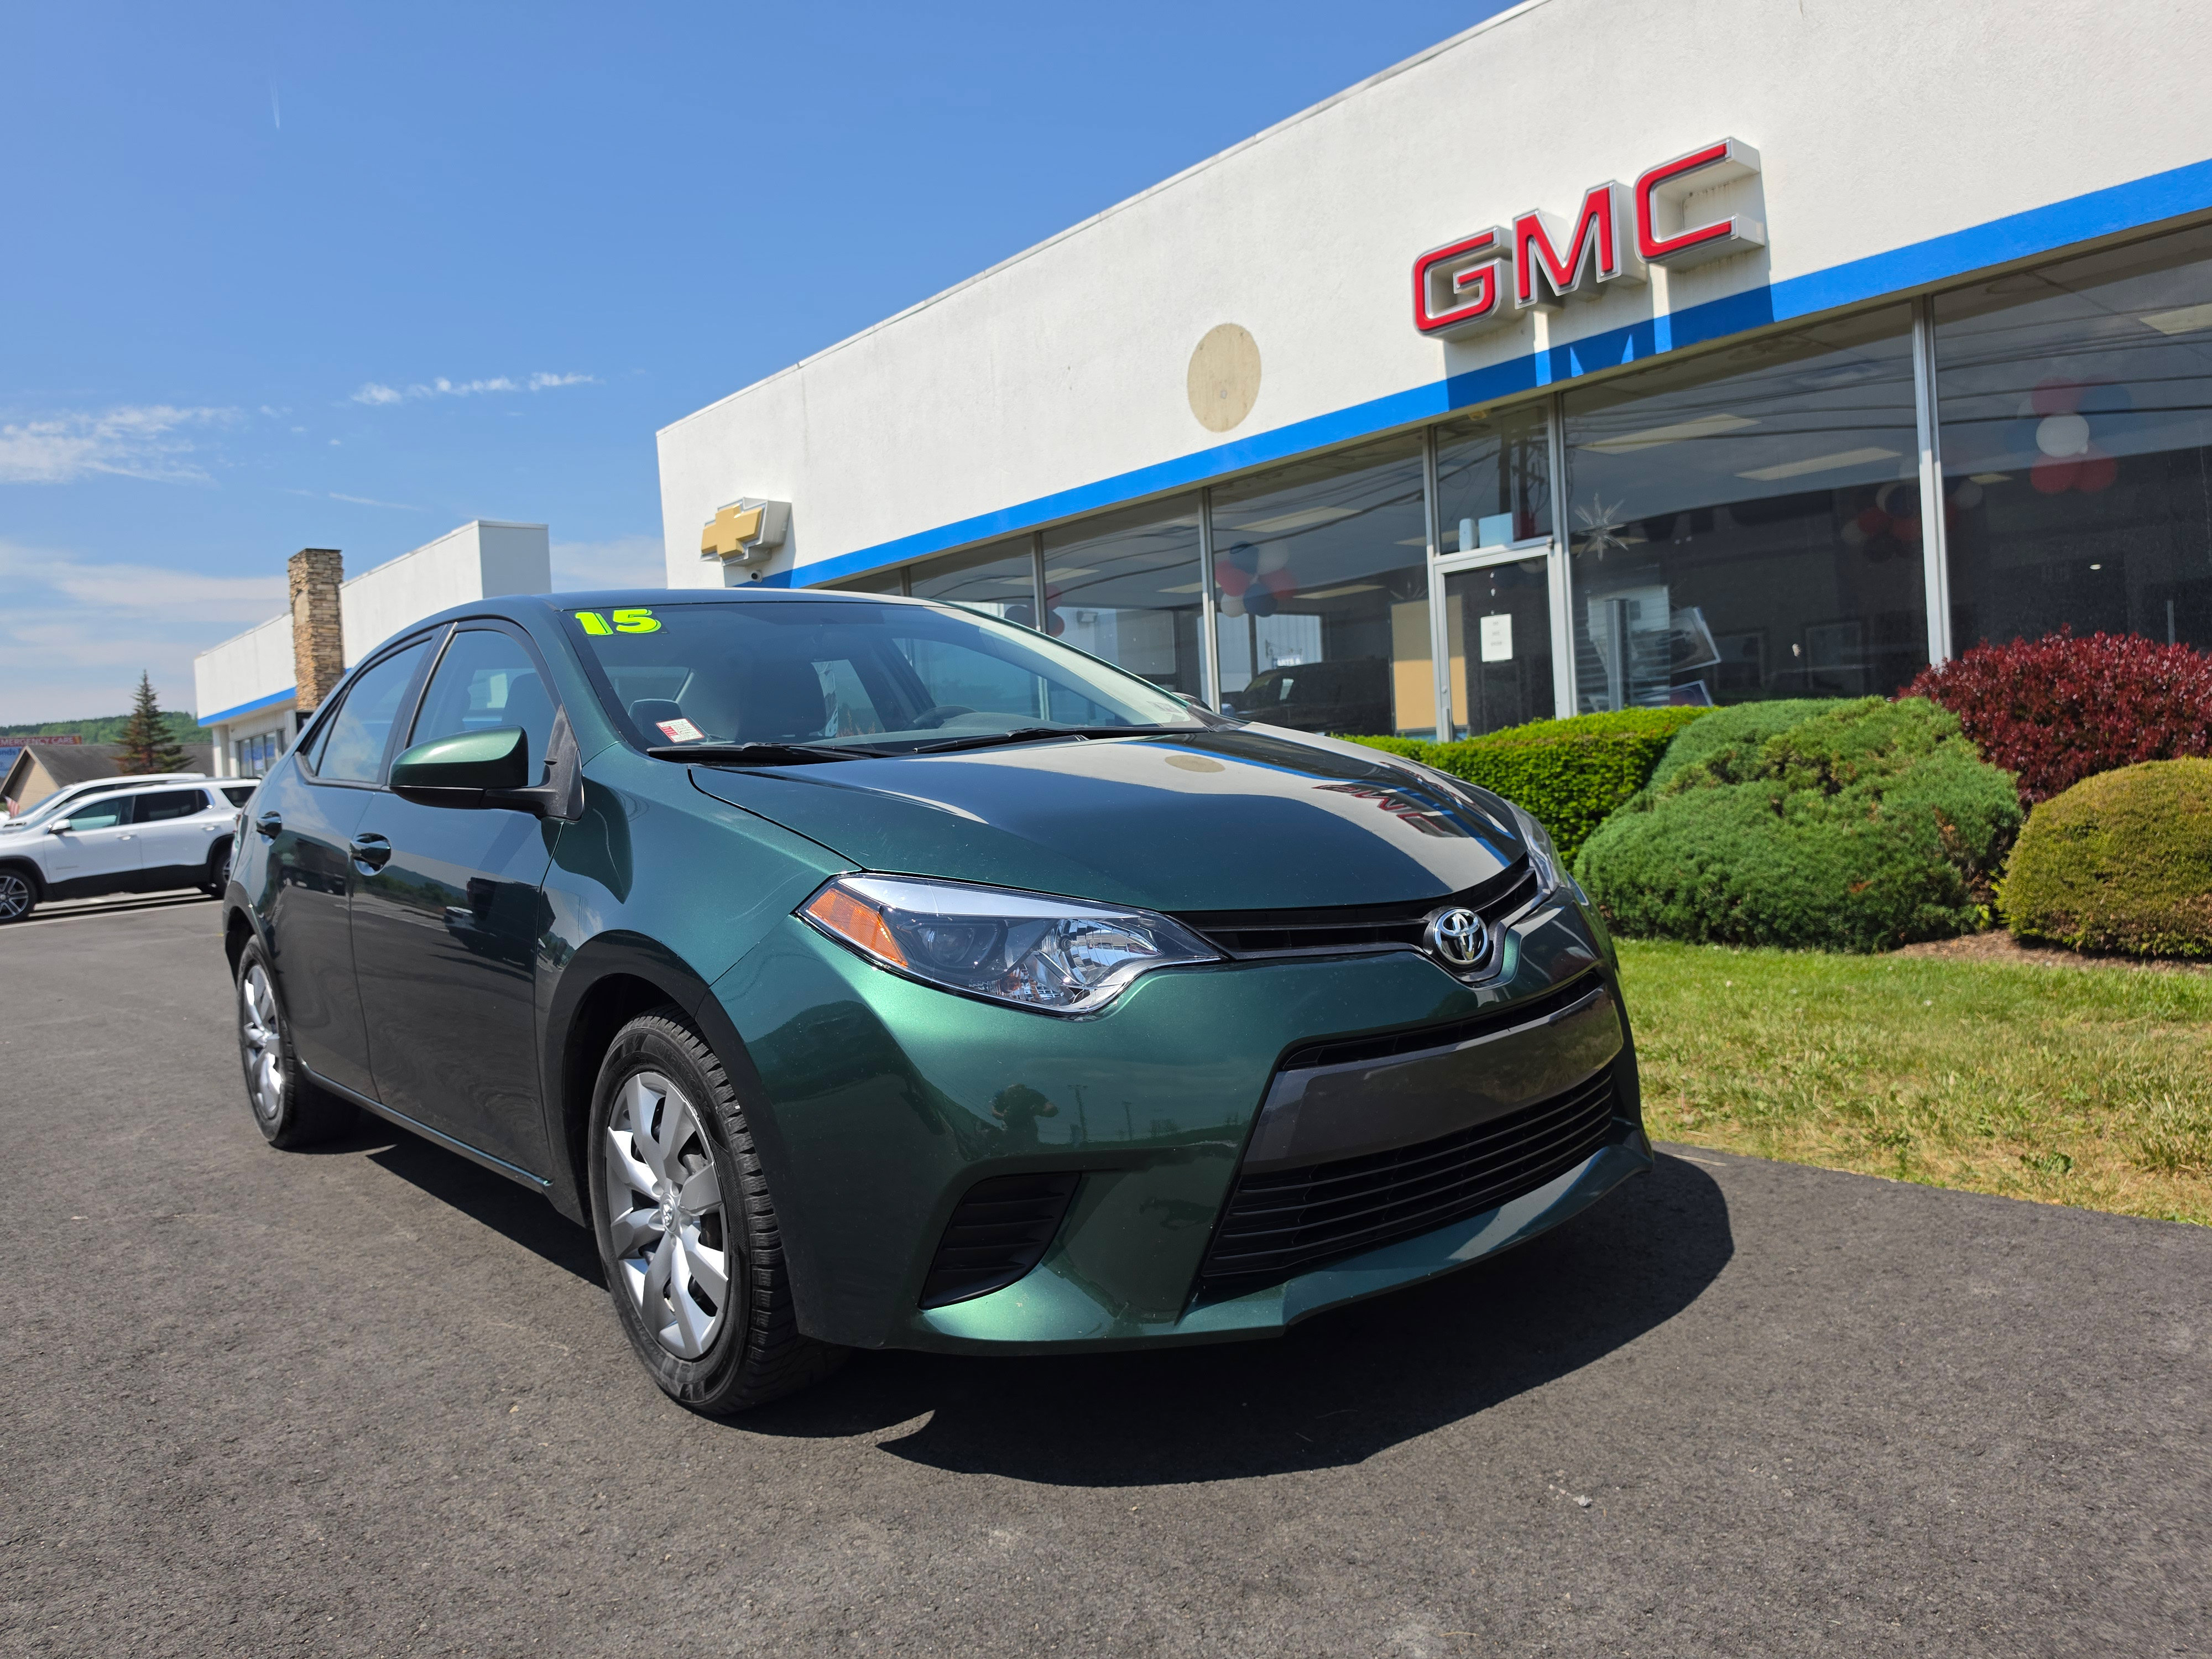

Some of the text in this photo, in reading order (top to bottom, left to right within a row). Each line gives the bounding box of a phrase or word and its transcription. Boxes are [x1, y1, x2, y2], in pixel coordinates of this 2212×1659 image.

[1412, 137, 1739, 337] GMC
[575, 608, 662, 635] 15
[0, 737, 50, 745] MERGENCY
